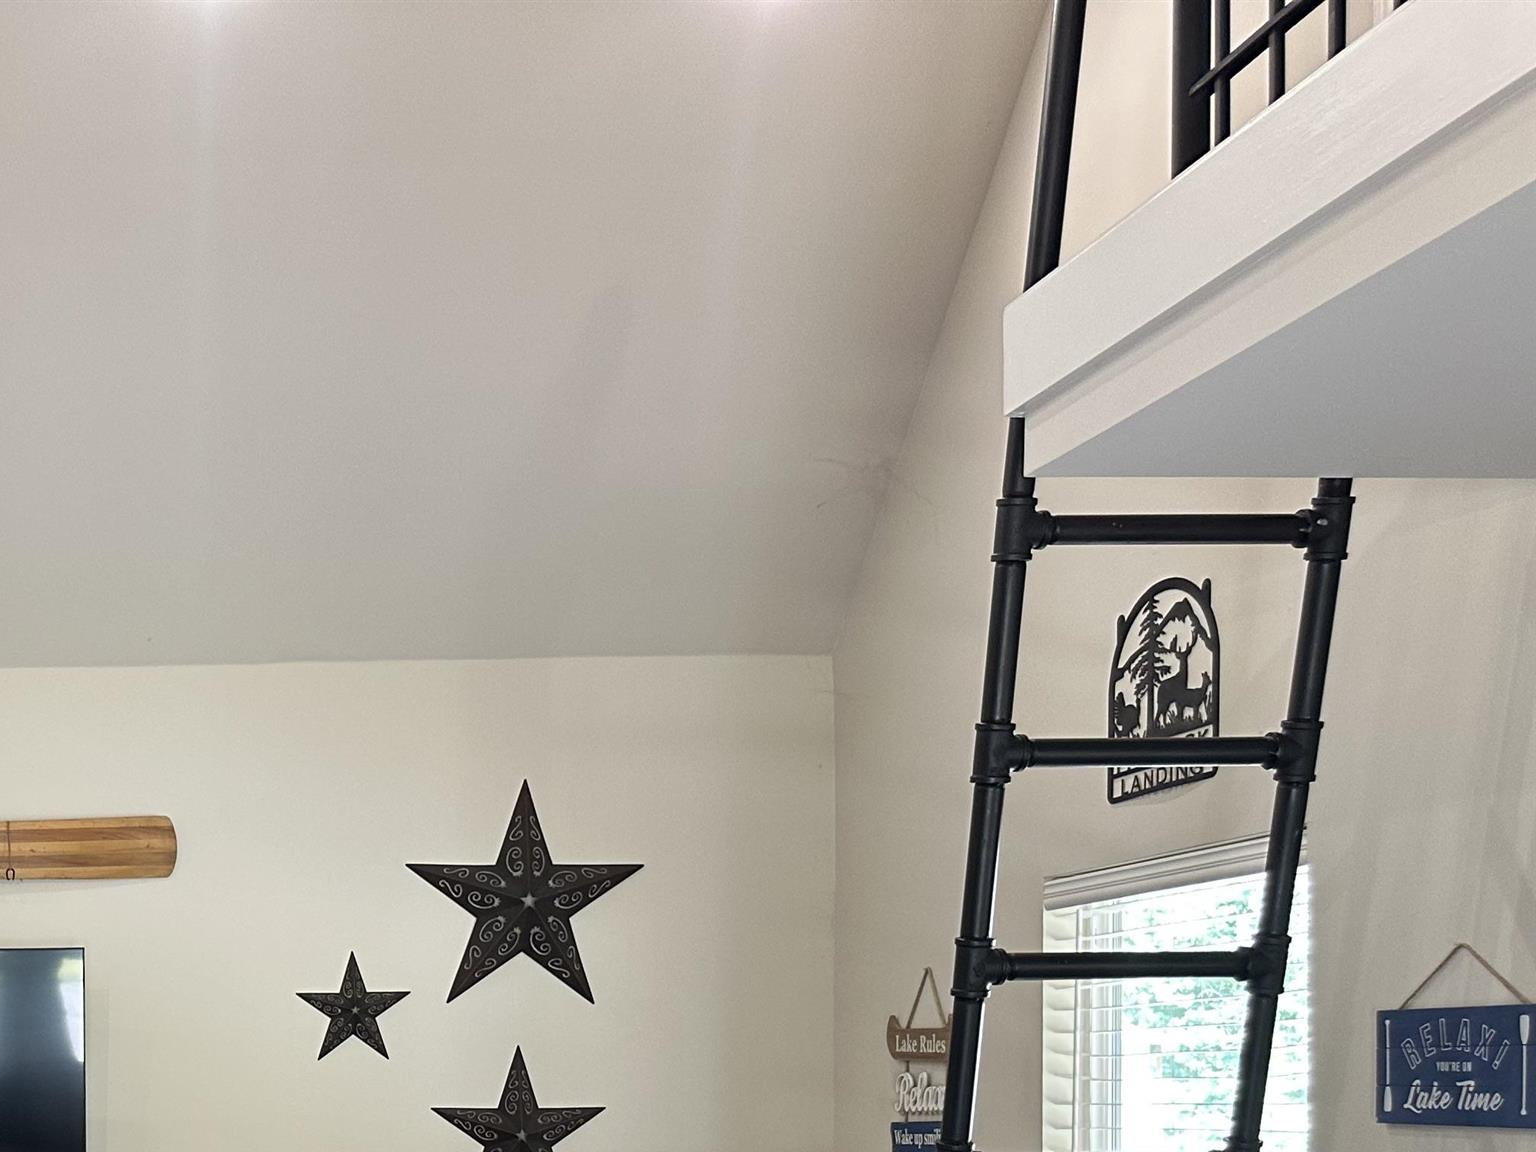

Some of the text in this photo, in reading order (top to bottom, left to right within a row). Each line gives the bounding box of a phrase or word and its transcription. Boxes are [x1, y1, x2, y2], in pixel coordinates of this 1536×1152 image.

[895, 1033, 946, 1053] Lake Rules
[1400, 1018, 1511, 1070] RELAX!
[1435, 1061, 1473, 1072] YOU'RE ON
[1403, 1079, 1504, 1114] Lake Time
[894, 1128, 914, 1145] Wake
[914, 1133, 923, 1149] up
